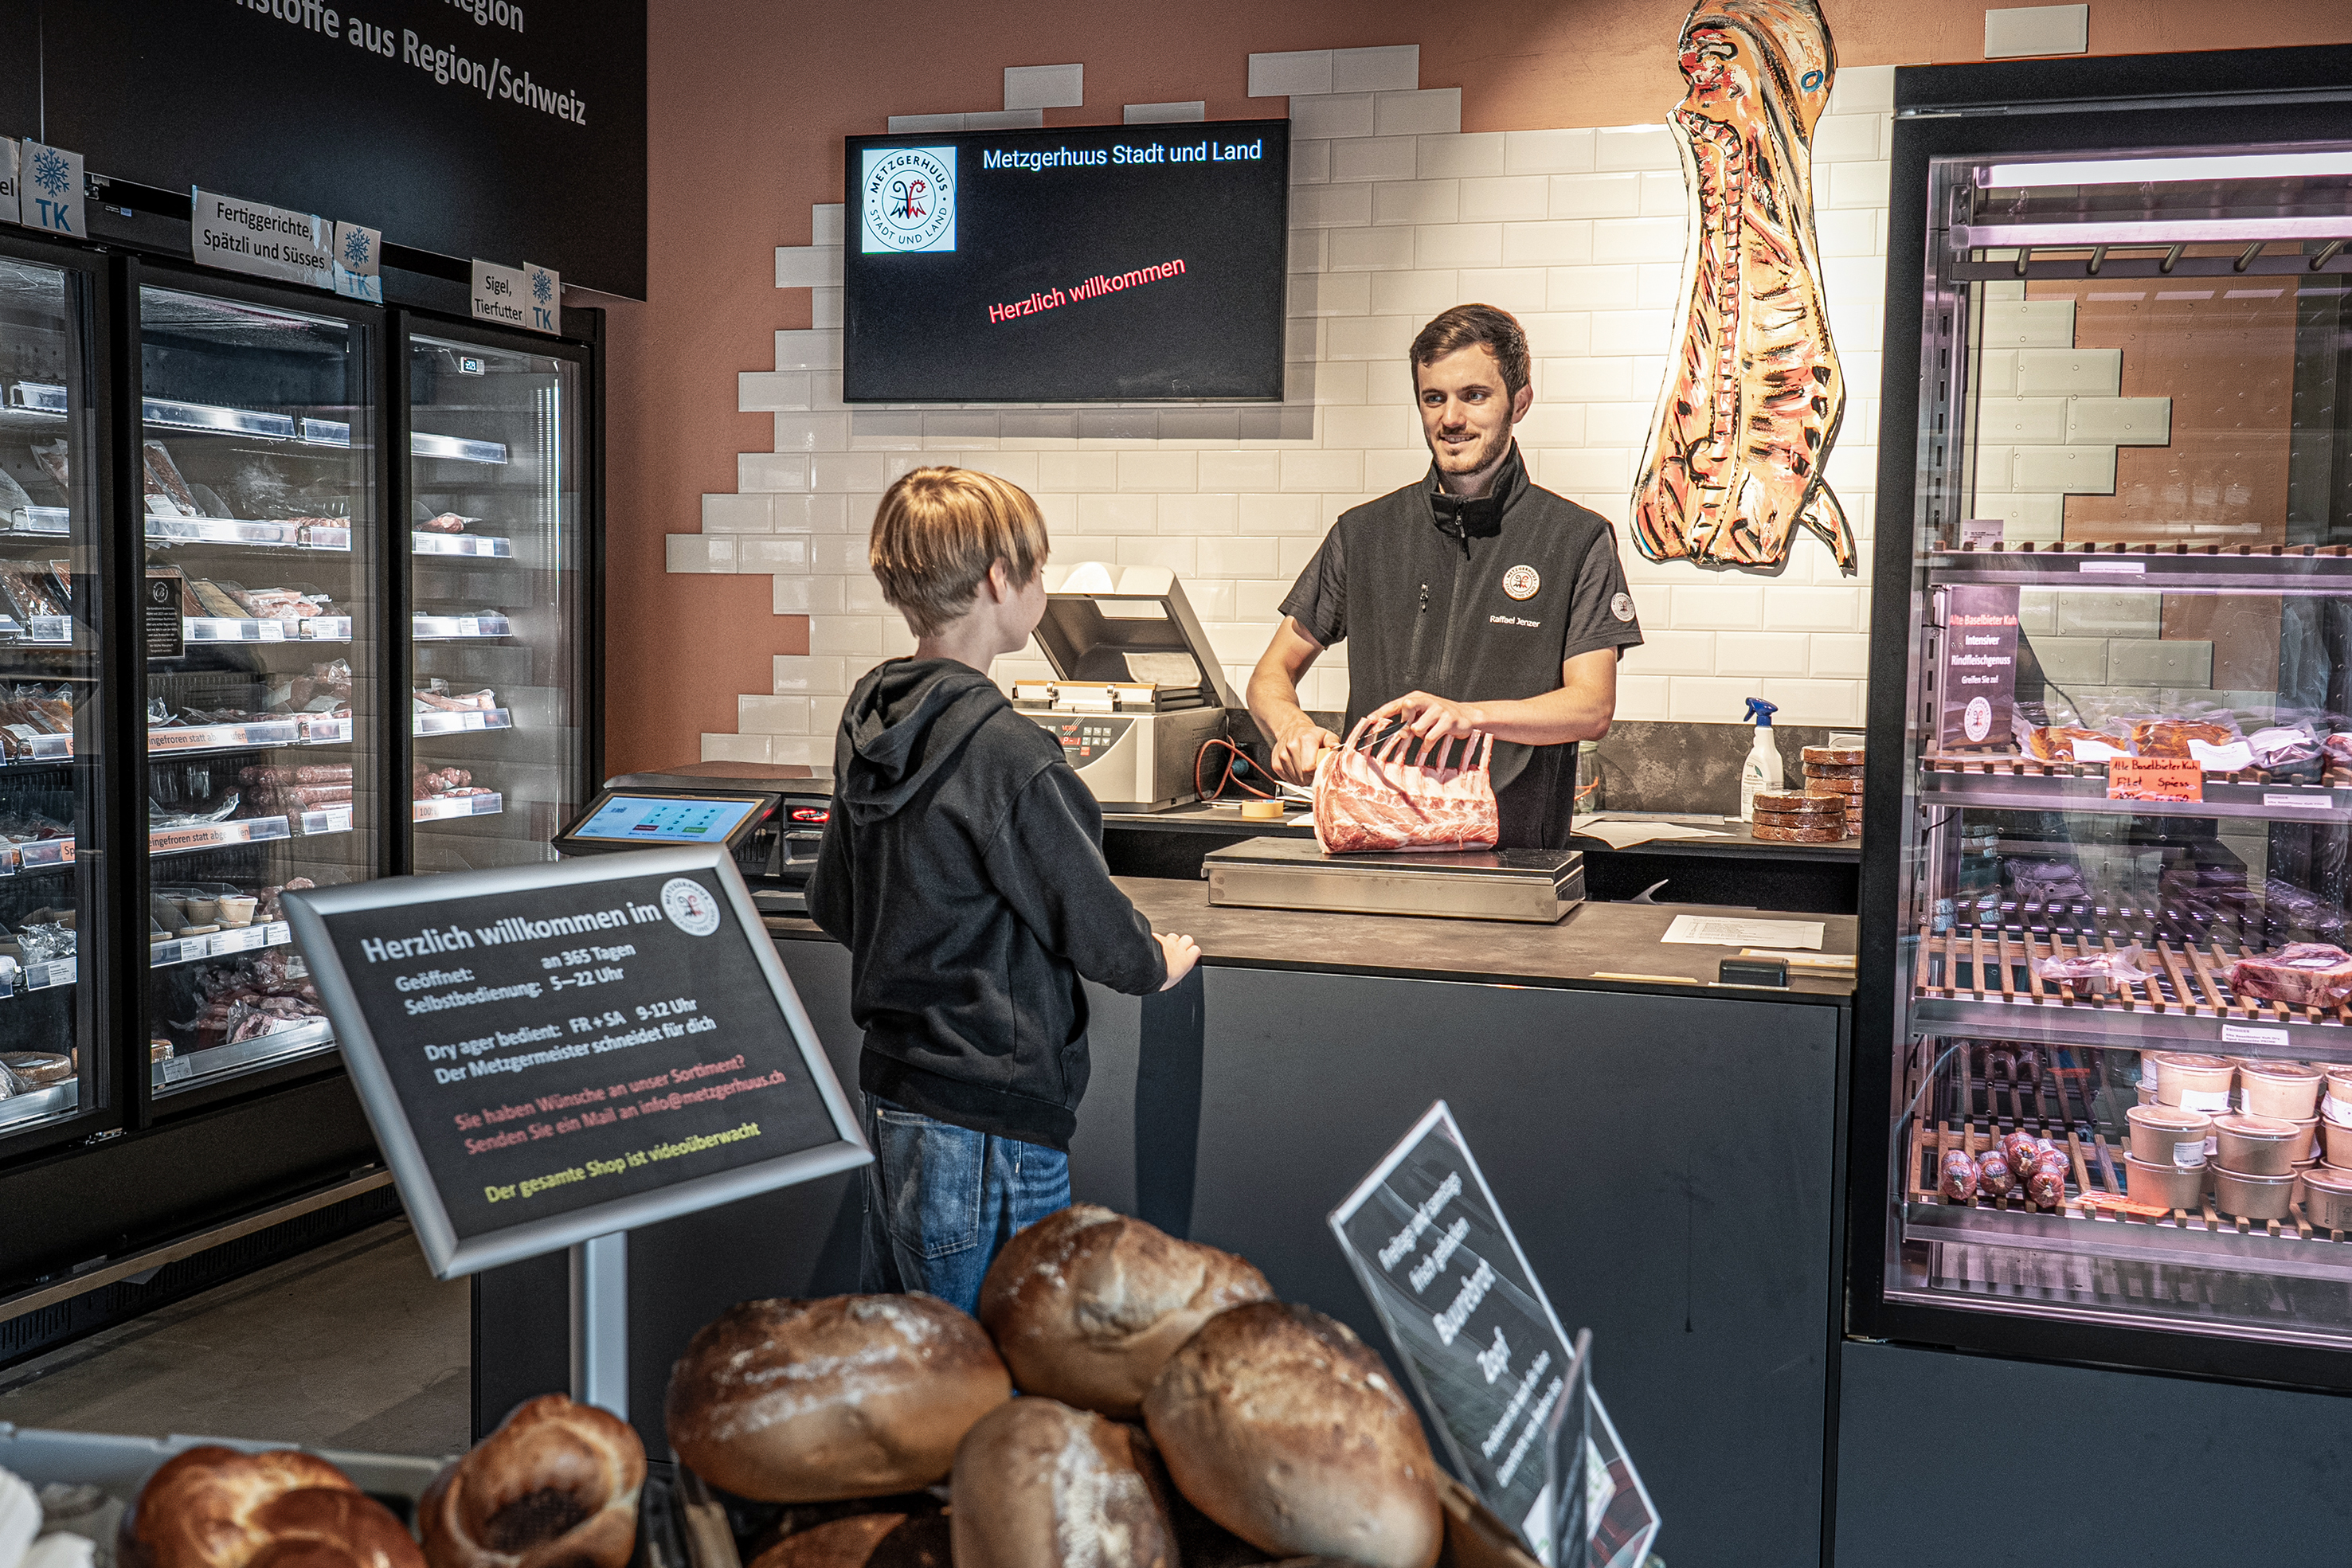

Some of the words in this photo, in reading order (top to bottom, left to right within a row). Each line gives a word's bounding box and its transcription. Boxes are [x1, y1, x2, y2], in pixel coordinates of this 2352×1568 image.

[348, 17, 395, 58] aus
[403, 29, 586, 126] Region/Schweiz
[983, 144, 1106, 171] Metzgerhuus
[1112, 143, 1164, 165] Stadt
[1170, 142, 1206, 162] und
[1212, 139, 1262, 161] Land
[870, 155, 948, 194] METZGERHUUS
[35, 198, 72, 233] TK
[217, 201, 314, 242] Fertiggerichte,
[870, 209, 895, 240] STADT
[898, 234, 922, 244] UND
[926, 208, 947, 237] LAND
[203, 229, 249, 256] Spätzli
[253, 238, 279, 260] und
[282, 245, 326, 270] Süsses
[345, 270, 371, 298] TK
[485, 276, 512, 297] Sigel,
[988, 287, 1066, 323] Herzlich
[1069, 257, 1185, 303] willkommen
[475, 298, 522, 321] Tierfutter
[533, 307, 554, 330] TK
[1489, 615, 1516, 625] Raffael
[1516, 616, 1540, 628] Jenzer
[1949, 615, 1963, 626] Alte
[1964, 614, 2003, 626] Baselbieter
[2003, 614, 2018, 626] Kuh
[1965, 635, 2000, 646] Intensiver
[1951, 654, 2011, 667] Rindfleischgenuss
[1962, 675, 1981, 685] Greifen
[1990, 675, 1998, 684] zu!
[190, 733, 206, 742] statt
[2131, 760, 2181, 770] Baselbieter
[2182, 761, 2197, 770] Kuh
[2117, 776, 2142, 786] Filet
[2158, 776, 2190, 790] Spiess
[193, 833, 209, 842] statt
[361, 925, 475, 964] Herzlich
[475, 907, 628, 945] willkommen
[626, 902, 663, 924] im
[541, 955, 562, 970] an
[560, 948, 591, 966] 365
[590, 943, 636, 962] Tagen
[395, 968, 475, 992] Geöffnet:
[405, 981, 543, 1015] Selbstbedienung:
[595, 967, 625, 984] Uhr
[424, 1042, 457, 1062] Dry
[459, 1036, 496, 1056] ager
[495, 1024, 563, 1047] bedient:
[569, 1017, 593, 1034] FR
[593, 1018, 604, 1028] +
[602, 1011, 628, 1027] SA
[636, 1003, 671, 1021] 9-12
[669, 997, 698, 1015] Uhr
[434, 1066, 468, 1085] Der
[468, 1042, 589, 1078] Metzgermeister
[591, 1026, 664, 1054] schneidet
[663, 1022, 685, 1038] für
[685, 1015, 718, 1034] dich
[455, 1111, 482, 1131] Sie
[482, 1101, 536, 1125] haben
[536, 1087, 606, 1114] Wünsche
[608, 1084, 628, 1098] an
[628, 1073, 669, 1093] unser
[670, 1054, 746, 1084] Sortiment?
[464, 1130, 529, 1155] Senden
[527, 1121, 555, 1140] Sie
[556, 1116, 581, 1135] ein
[581, 1108, 617, 1128] Mail
[618, 1105, 639, 1120] an
[638, 1069, 786, 1115] info@metzgerhuus.ch
[483, 1183, 518, 1203] Der
[519, 1167, 587, 1198] gesamte
[585, 1155, 628, 1179] Shop
[625, 1151, 649, 1167] ist
[648, 1121, 762, 1162] videoüberwacht
[1477, 1325, 1512, 1385] Zopf
